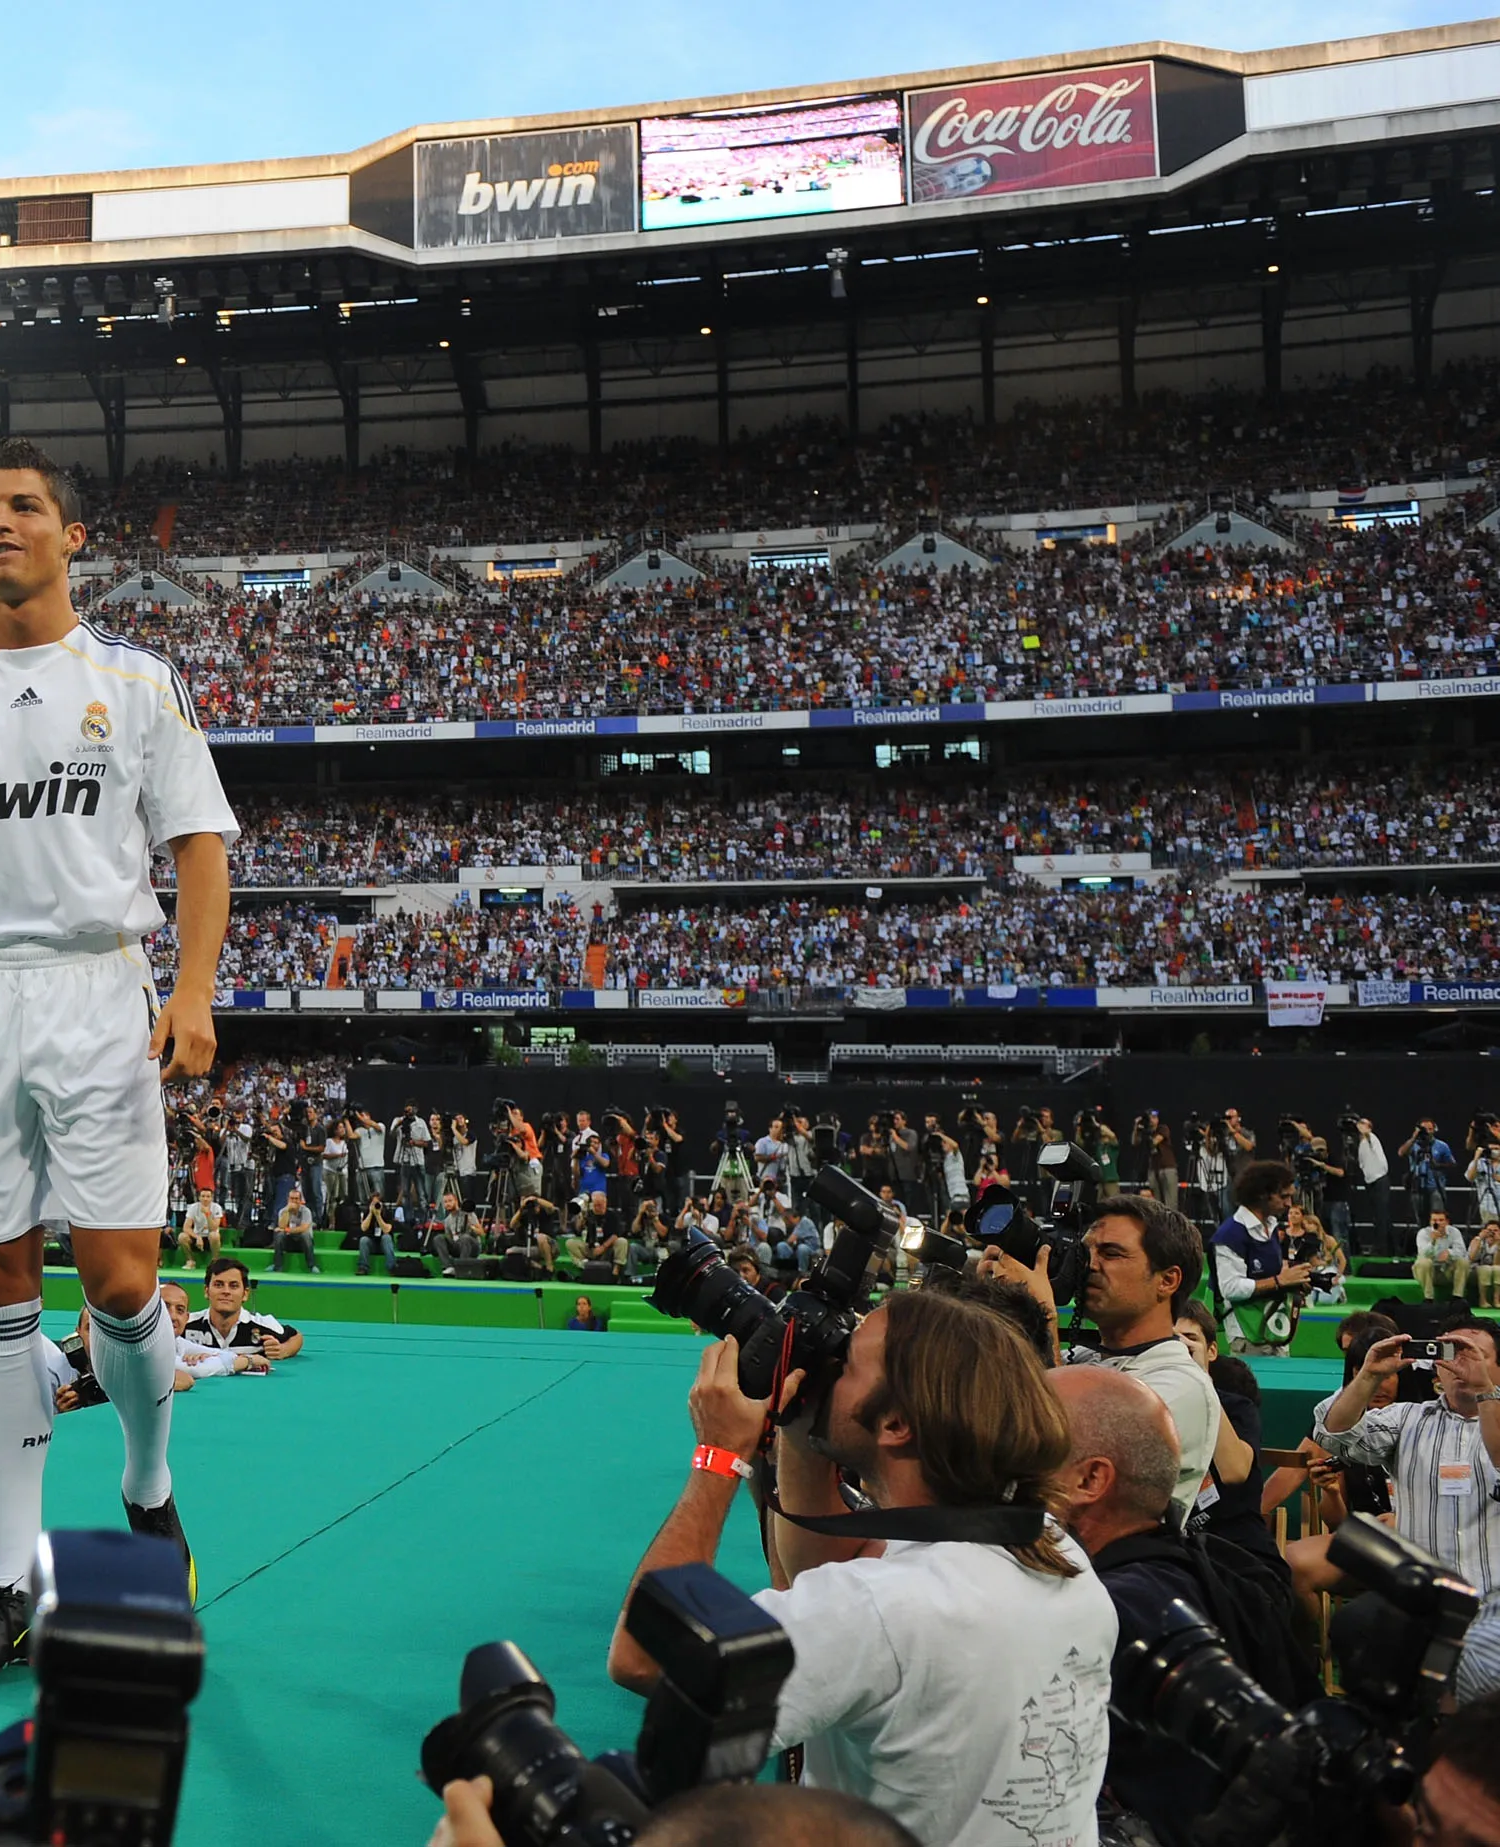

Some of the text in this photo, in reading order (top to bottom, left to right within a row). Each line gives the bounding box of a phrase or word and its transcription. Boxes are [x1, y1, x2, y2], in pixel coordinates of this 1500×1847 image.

[914, 77, 1144, 164] Coca-Cola
[457, 164, 597, 216] bwin
[10, 698, 43, 709] adidas
[1033, 698, 1123, 715] Realmadrid
[1220, 689, 1315, 709] Realmadrid
[681, 714, 764, 730] Realmadrid
[853, 706, 941, 725] Realmadrid
[355, 725, 432, 740] Realmadrid
[515, 719, 596, 735] Realmadrid
[461, 990, 550, 1008] Realmadrid
[1150, 986, 1250, 1005] Realmadrid
